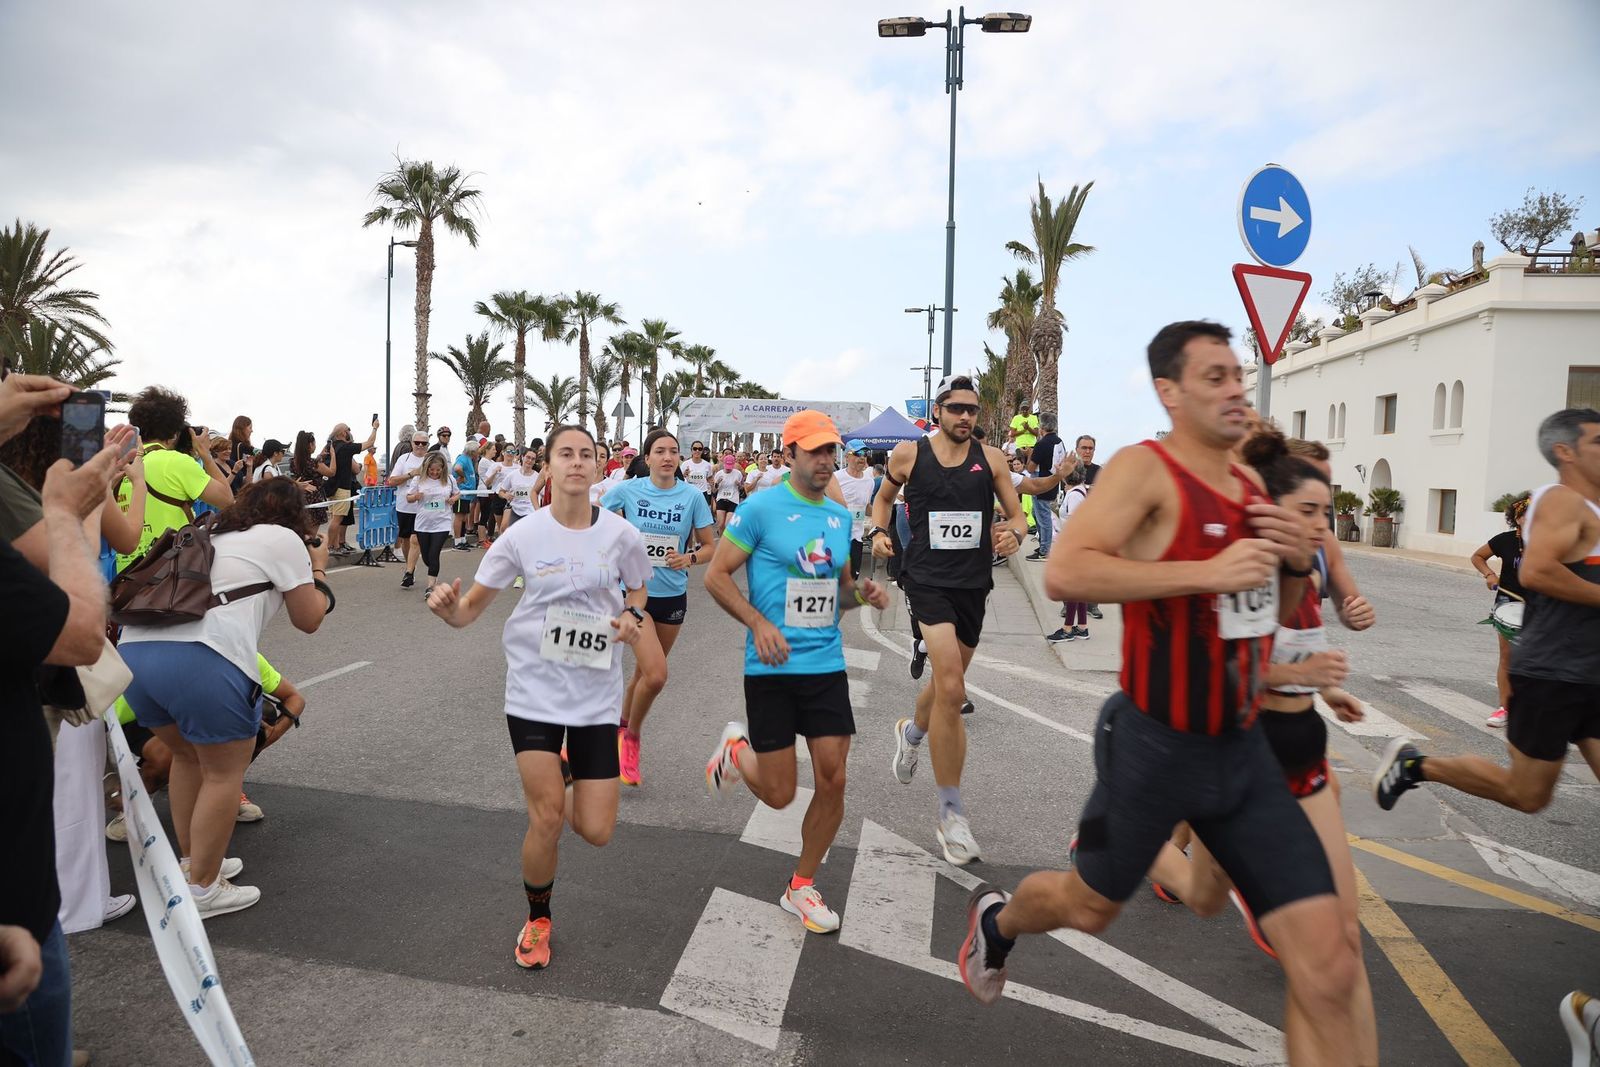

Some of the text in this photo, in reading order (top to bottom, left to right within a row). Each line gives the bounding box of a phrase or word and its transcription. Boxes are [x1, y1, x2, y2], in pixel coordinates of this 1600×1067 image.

[752, 405, 795, 413] CARRERA
[637, 507, 682, 524] nerja
[940, 525, 972, 538] 702
[793, 596, 834, 612] 1271
[550, 626, 608, 652] 1185
